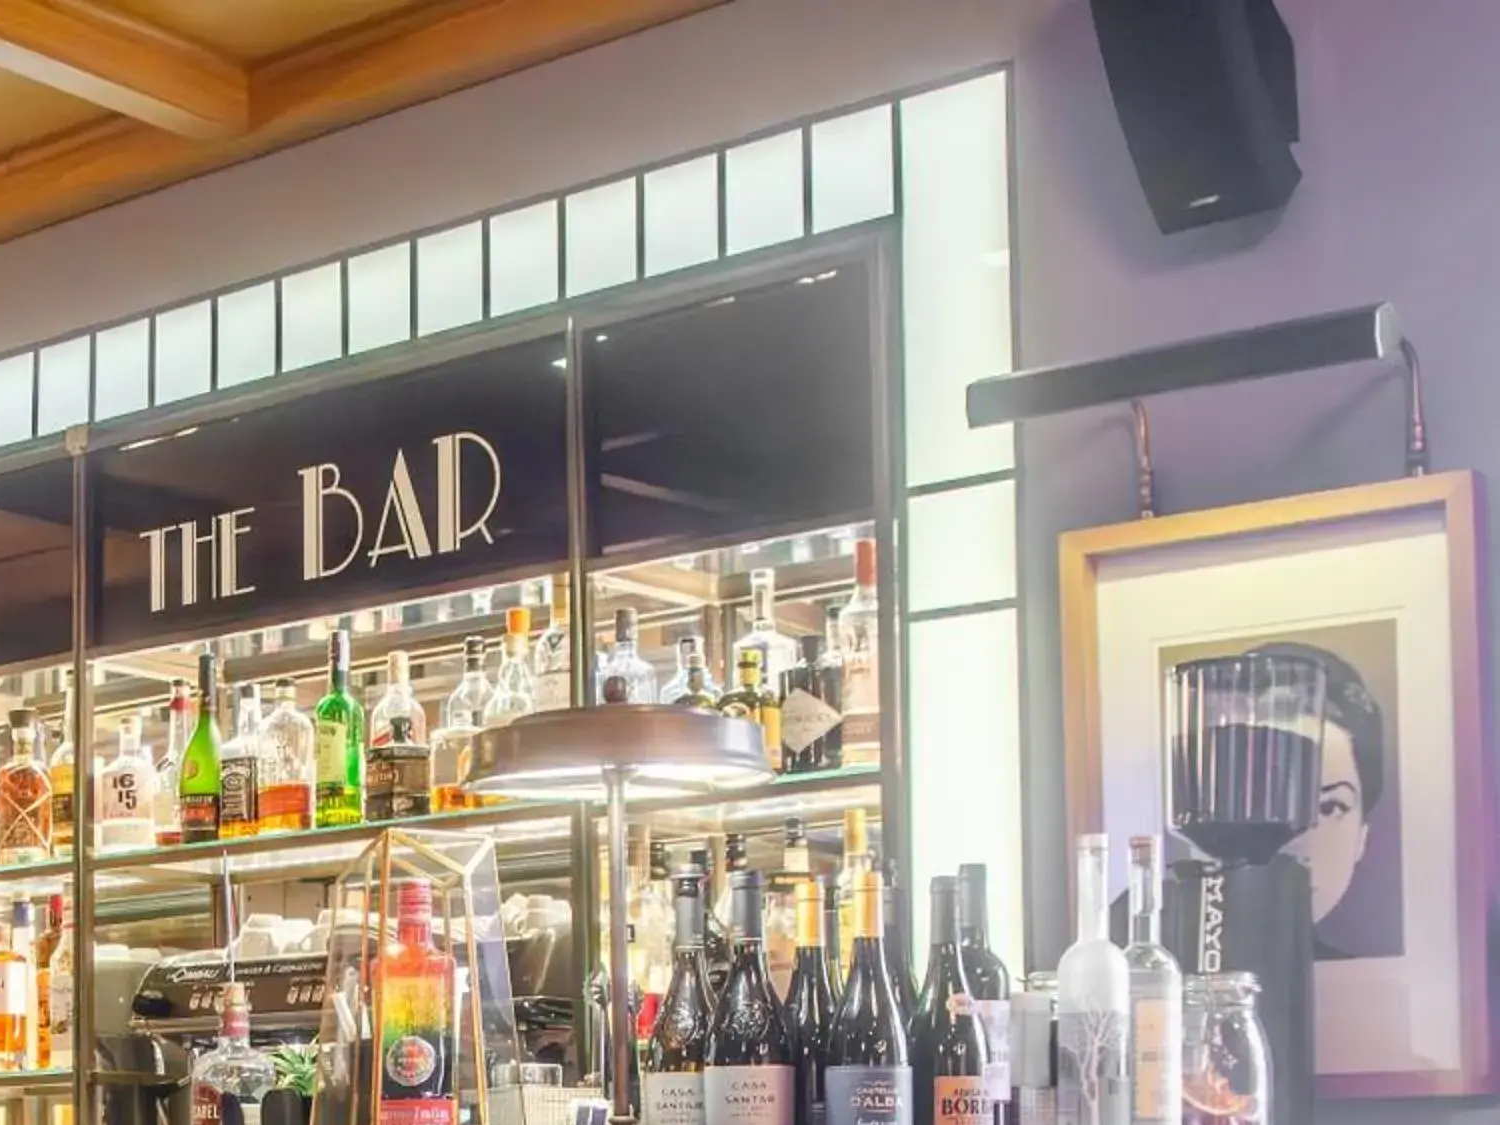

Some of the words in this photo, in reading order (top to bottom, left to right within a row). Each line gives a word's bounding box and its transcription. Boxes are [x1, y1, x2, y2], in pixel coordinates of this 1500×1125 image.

[139, 506, 255, 612] THE
[297, 431, 501, 581] BAR
[113, 773, 135, 790] 16
[117, 789, 137, 811] 15
[731, 1080, 768, 1090] CASA
